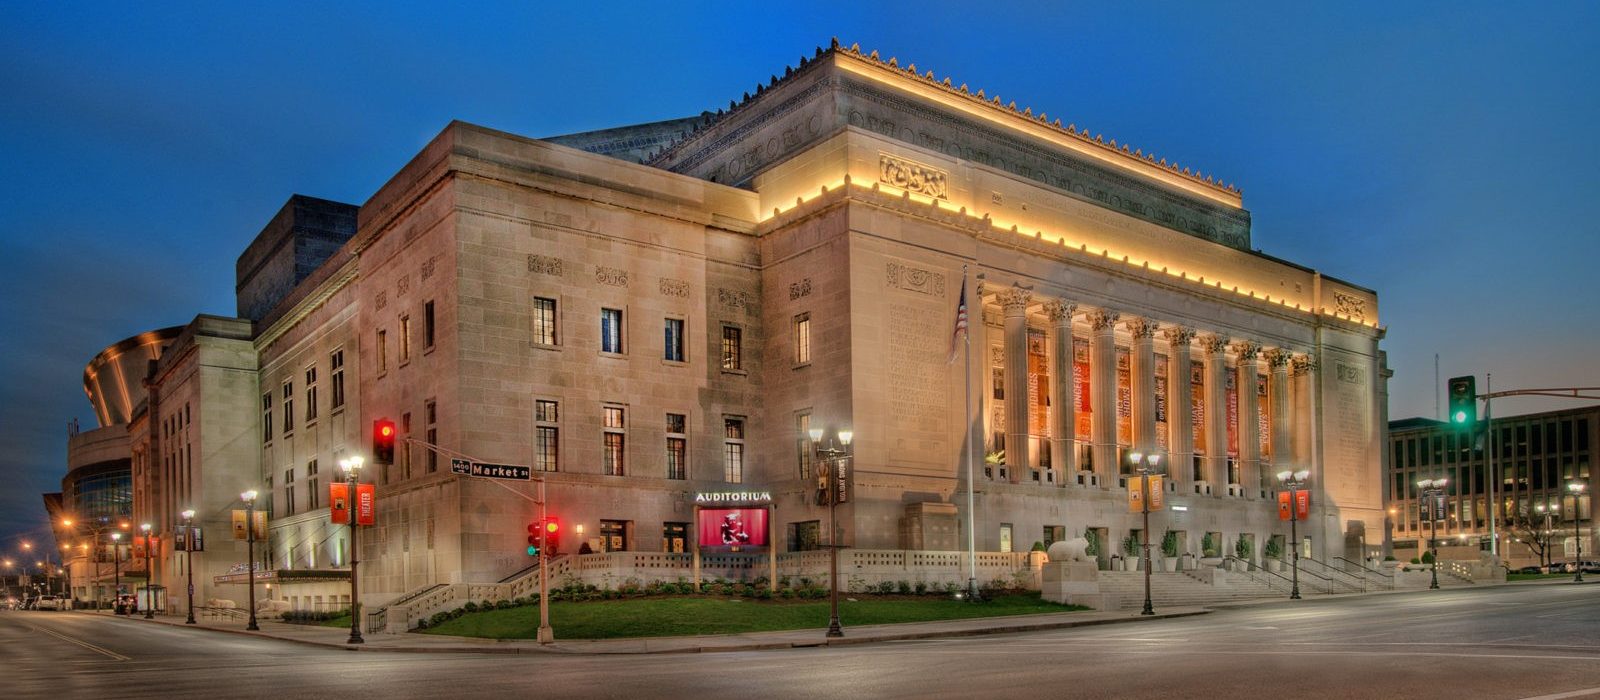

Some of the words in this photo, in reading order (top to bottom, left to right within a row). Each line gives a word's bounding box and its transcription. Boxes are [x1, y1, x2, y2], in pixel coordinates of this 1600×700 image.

[1029, 372, 1039, 423] WEDDINGS
[1230, 392, 1238, 428] THEATER
[473, 465, 518, 477] Market
[361, 492, 371, 517] THEATER
[696, 491, 771, 502] AUDITORIUM
